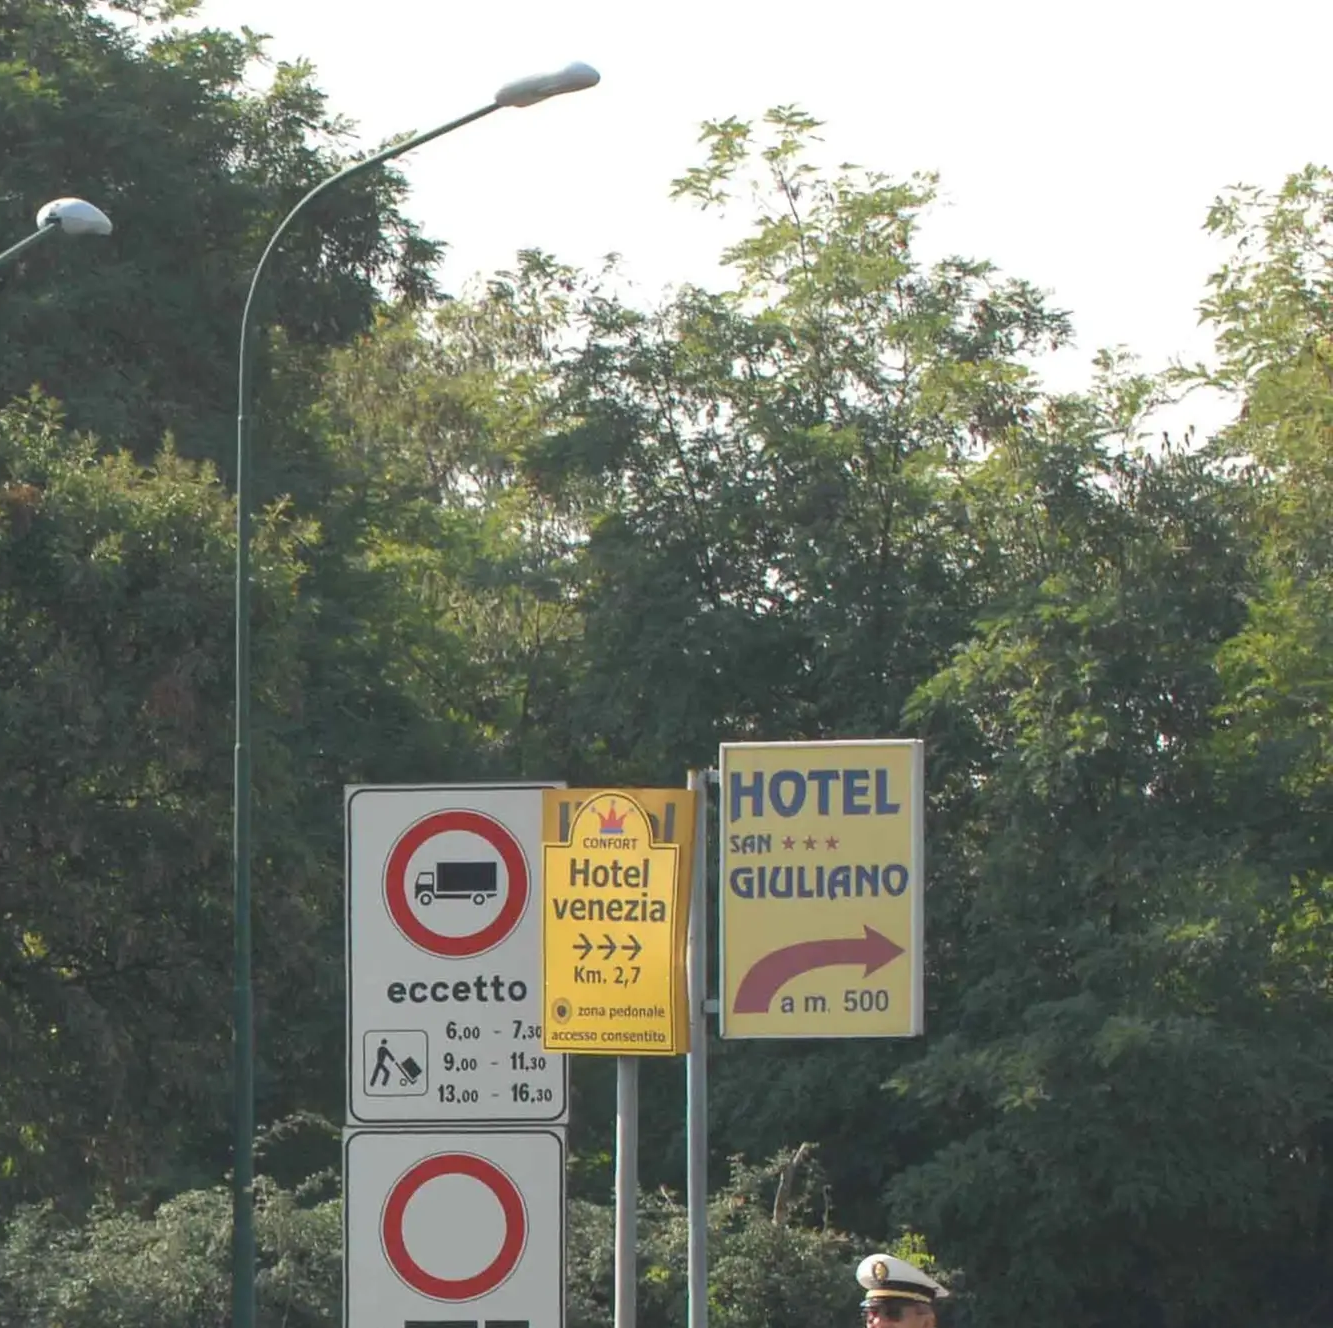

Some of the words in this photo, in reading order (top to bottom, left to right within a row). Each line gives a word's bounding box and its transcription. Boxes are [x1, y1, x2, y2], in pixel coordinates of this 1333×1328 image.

[730, 769, 900, 822] HOTEL
[583, 837, 638, 850] CONFORT
[729, 834, 772, 855] SAN
[568, 858, 650, 889] Hotel
[730, 864, 909, 900] GIULIANO
[574, 966, 608, 984] Km.
[613, 966, 641, 989] 2,7
[387, 975, 528, 1004] eccetto
[577, 1006, 606, 1017] zona
[609, 1005, 666, 1020] pedonale
[781, 995, 795, 1014] a
[843, 990, 889, 1012] 500
[551, 1031, 598, 1042] accesso
[601, 1030, 666, 1043] consentito
